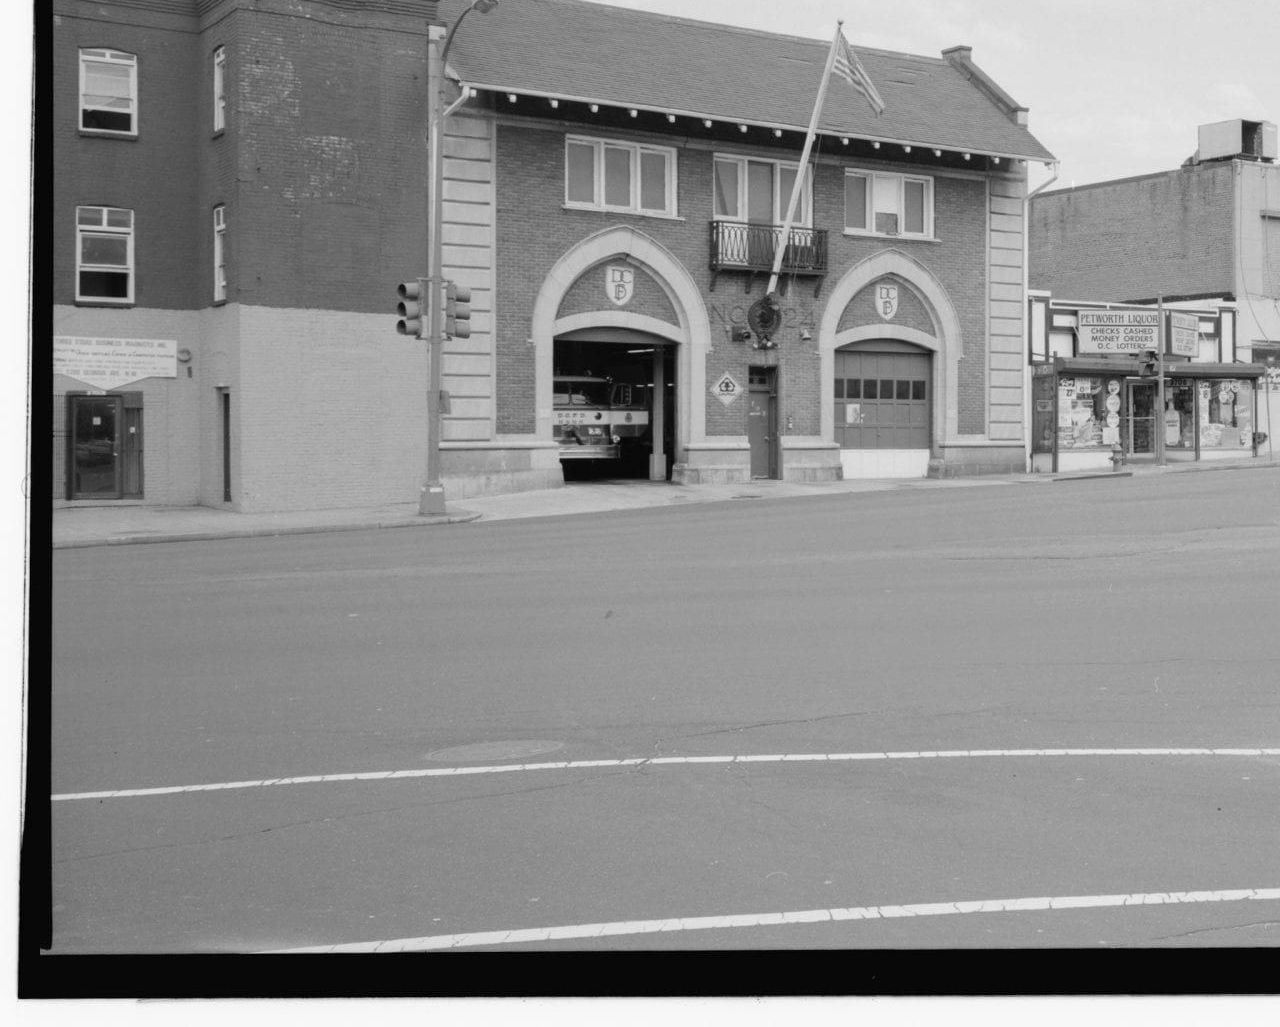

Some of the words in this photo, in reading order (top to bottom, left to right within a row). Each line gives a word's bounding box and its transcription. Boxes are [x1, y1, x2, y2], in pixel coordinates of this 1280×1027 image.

[1080, 314, 1124, 324] PETWORTH
[1091, 327, 1120, 335] CHECKS
[1123, 327, 1154, 335] CASHED
[1097, 342, 1113, 350] D.C.
[1116, 342, 1146, 350] LOTTERY
